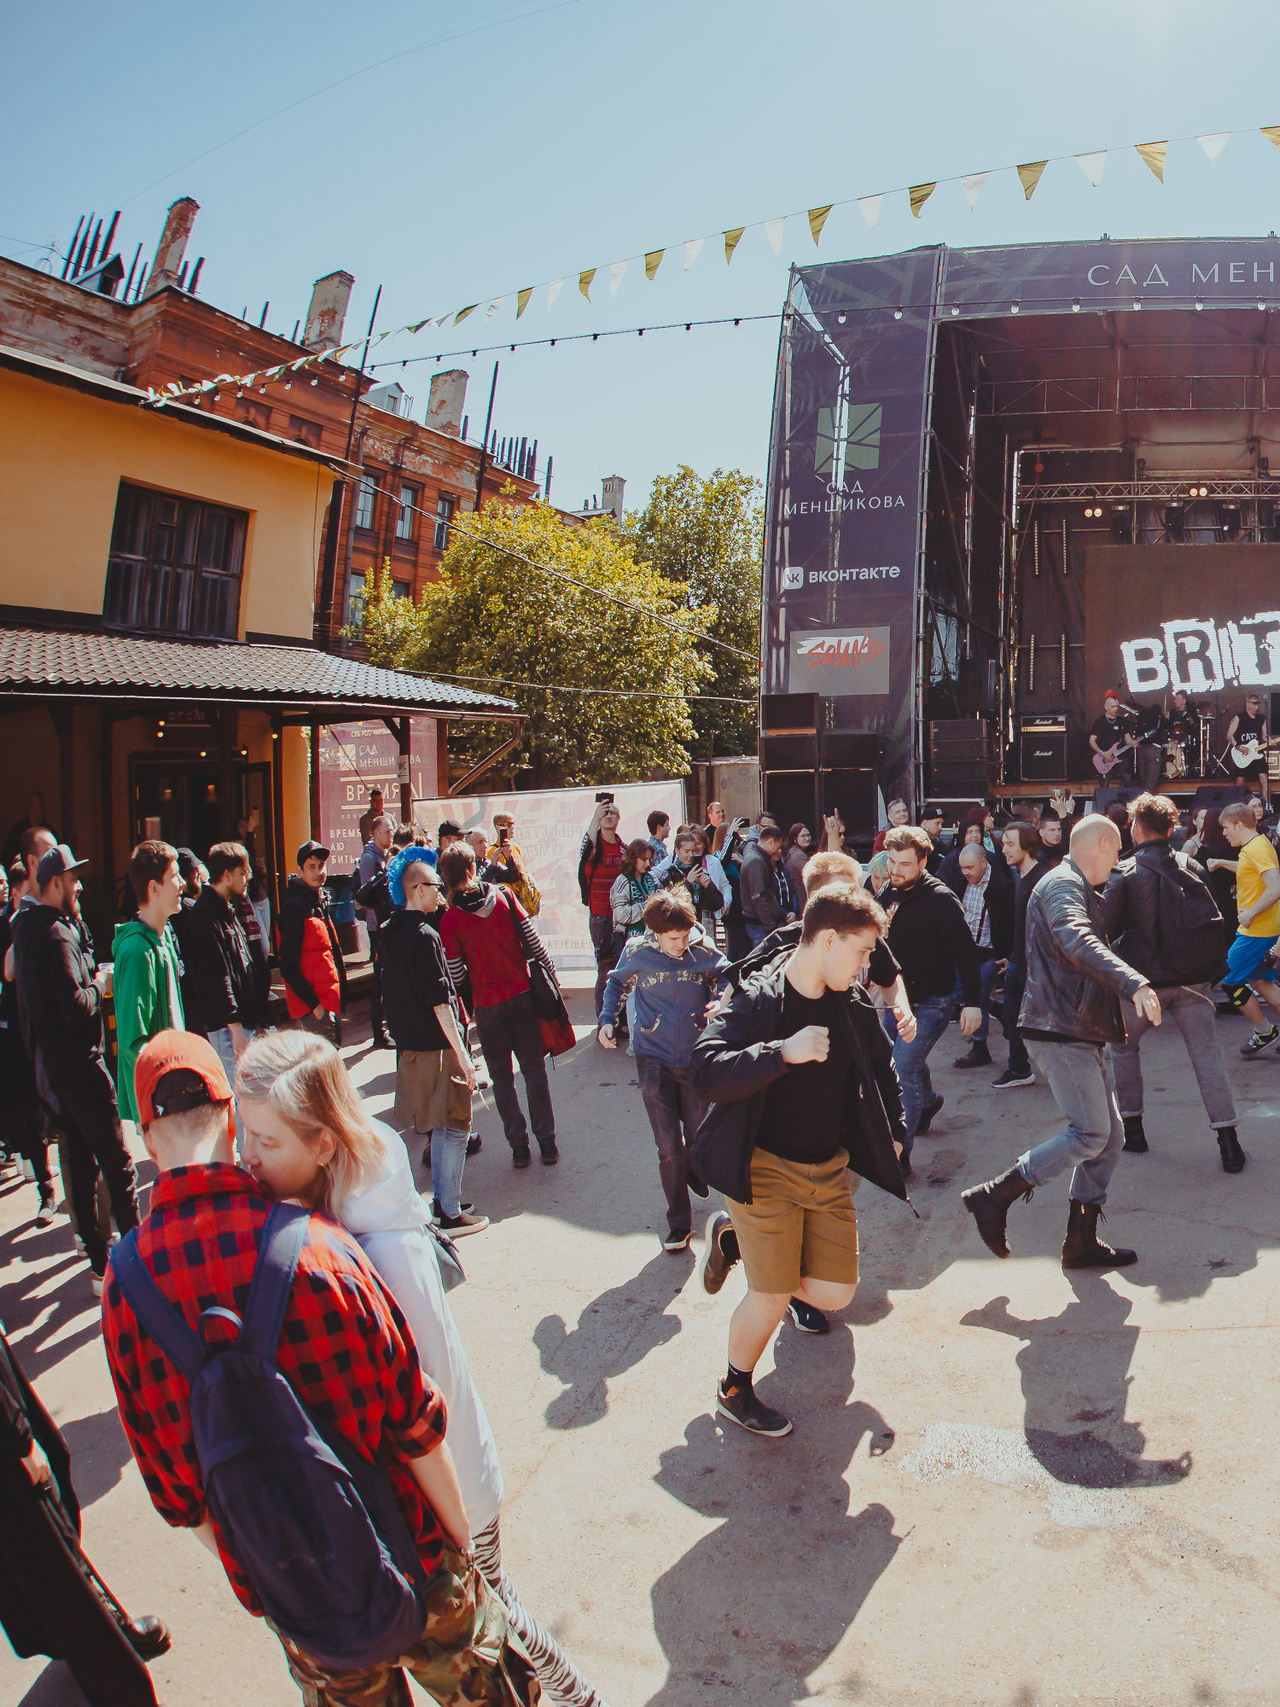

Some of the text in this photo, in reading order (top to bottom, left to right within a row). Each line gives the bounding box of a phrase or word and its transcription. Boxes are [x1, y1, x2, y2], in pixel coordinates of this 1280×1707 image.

[1087, 264, 1168, 287] САД
[826, 480, 863, 494] САД
[783, 495, 905, 515] МЕНШИКОВА
[359, 745, 378, 756] САД
[330, 829, 361, 839] ВРЕМЯ
